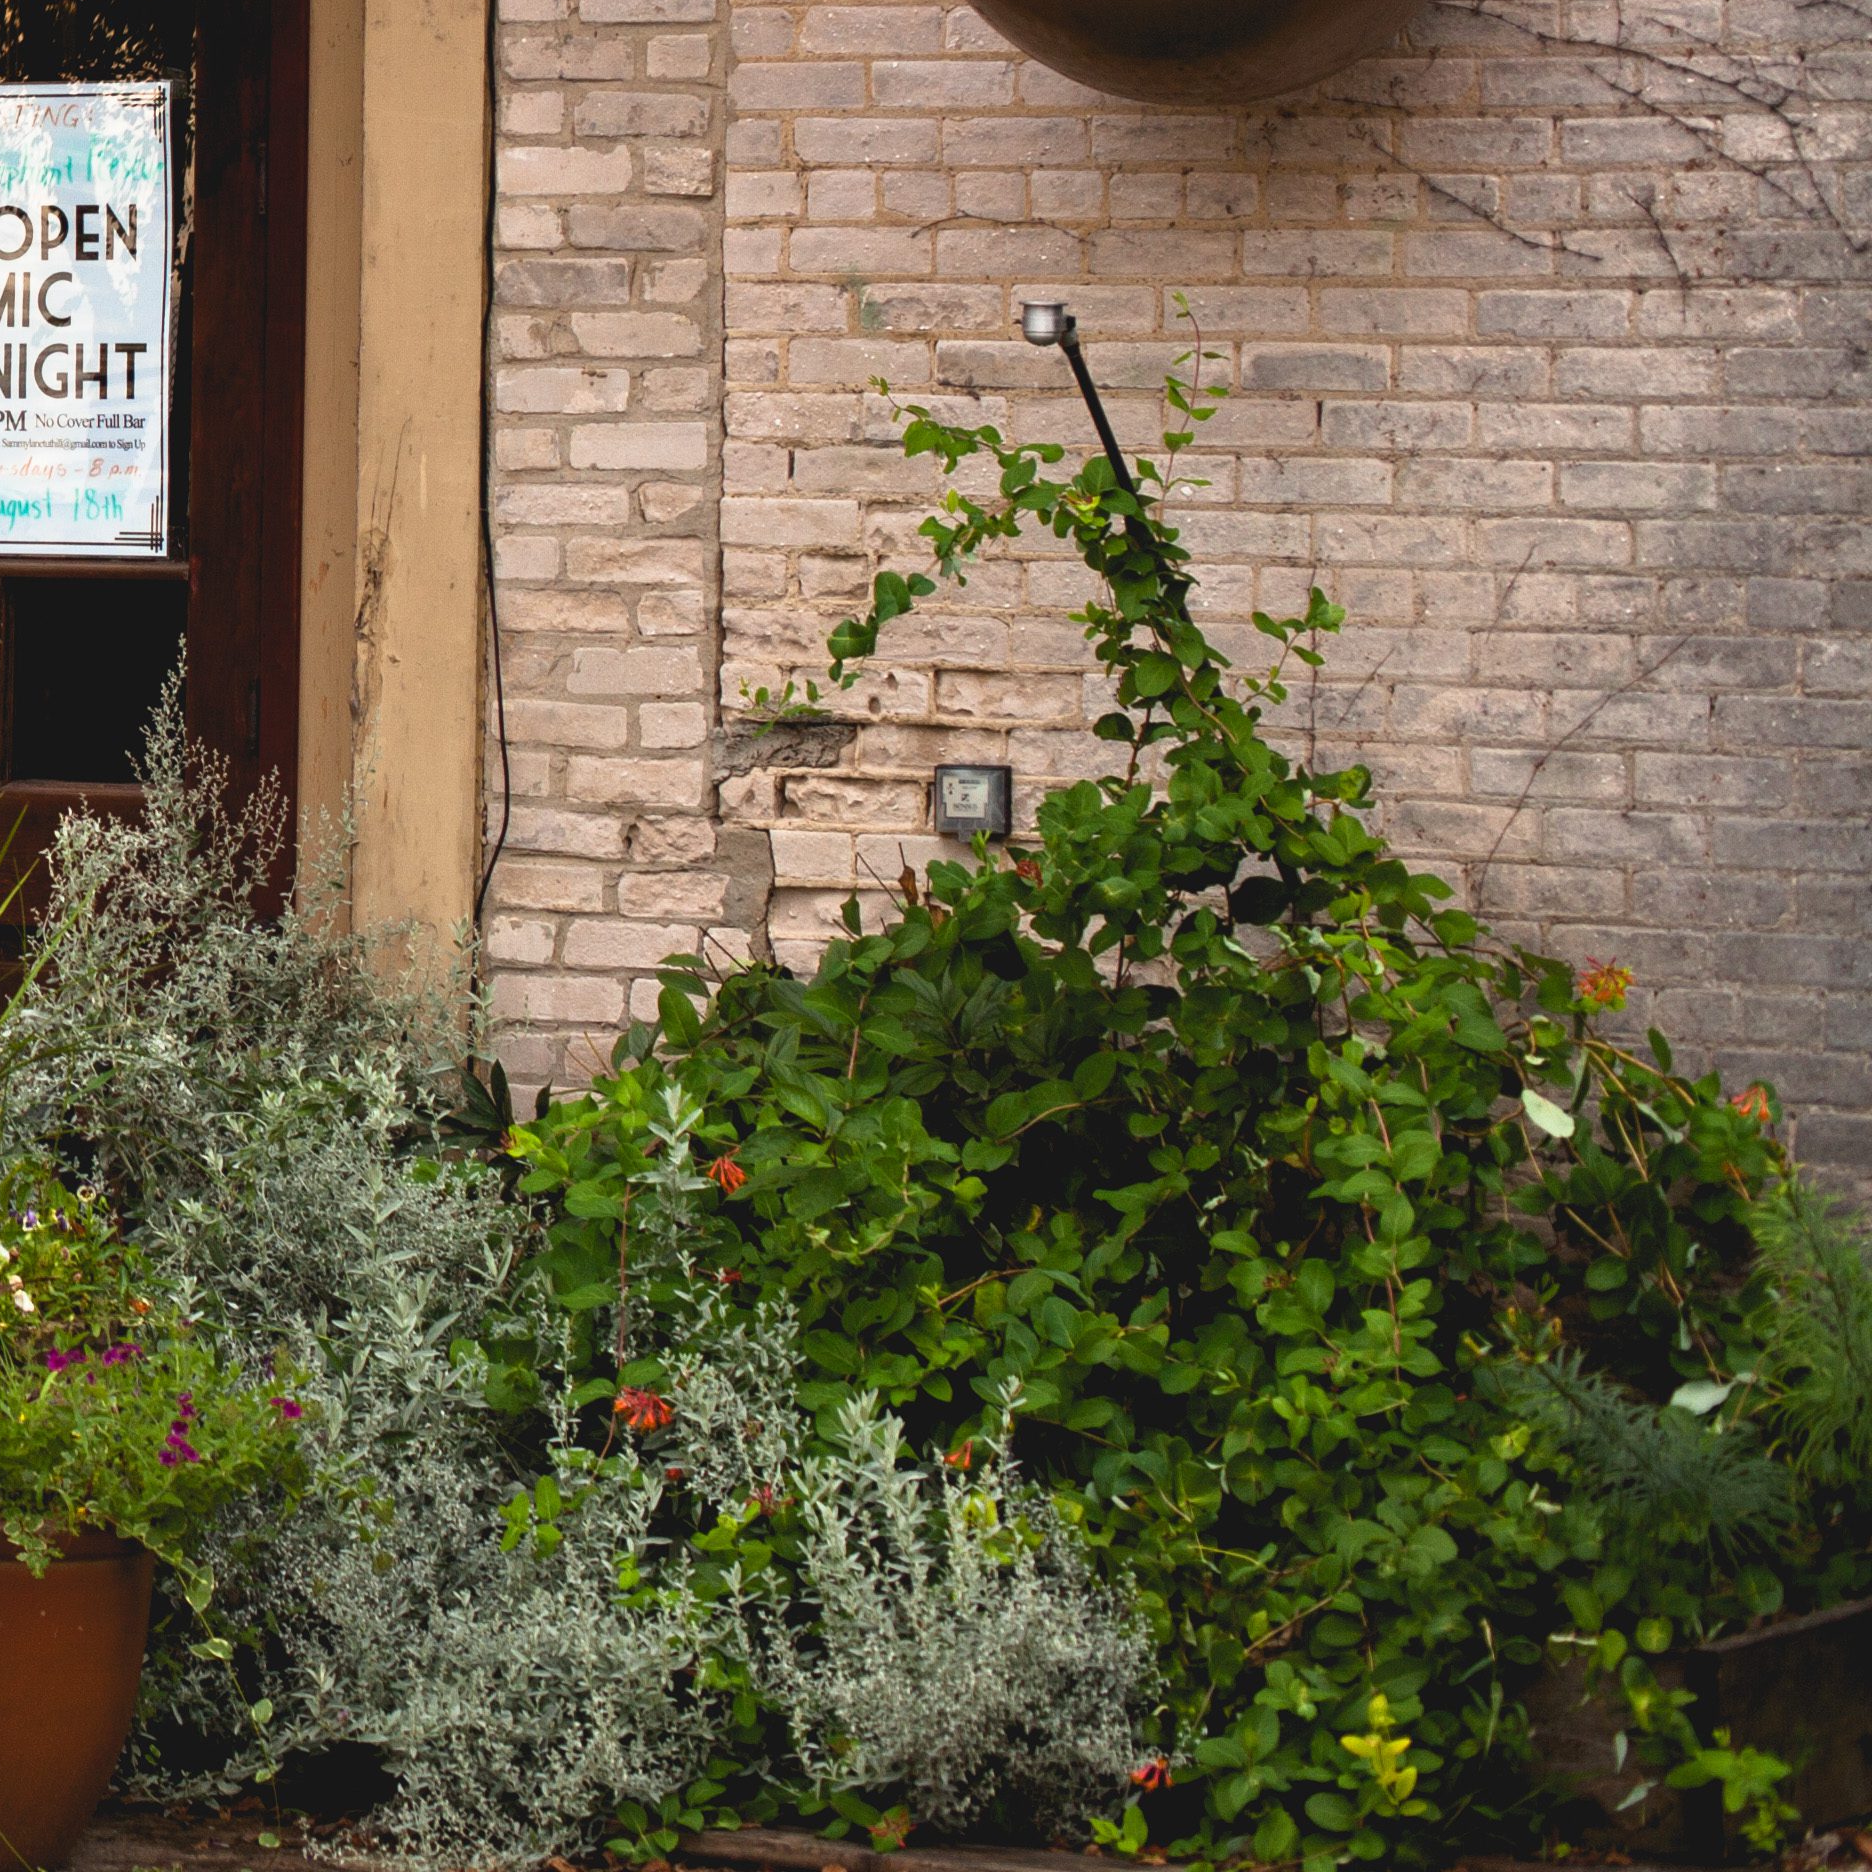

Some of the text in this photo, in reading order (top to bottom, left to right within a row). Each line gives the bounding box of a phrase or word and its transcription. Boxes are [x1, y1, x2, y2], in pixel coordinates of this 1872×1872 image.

[35, 413, 55, 429] No
[56, 414, 94, 429] Cover
[96, 414, 120, 429] Full
[123, 414, 146, 429] Bar
[108, 438, 116, 449] to
[117, 438, 133, 451] Sign
[134, 438, 146, 451] Up
[88, 457, 104, 478] 8
[72, 487, 124, 522] 18th
